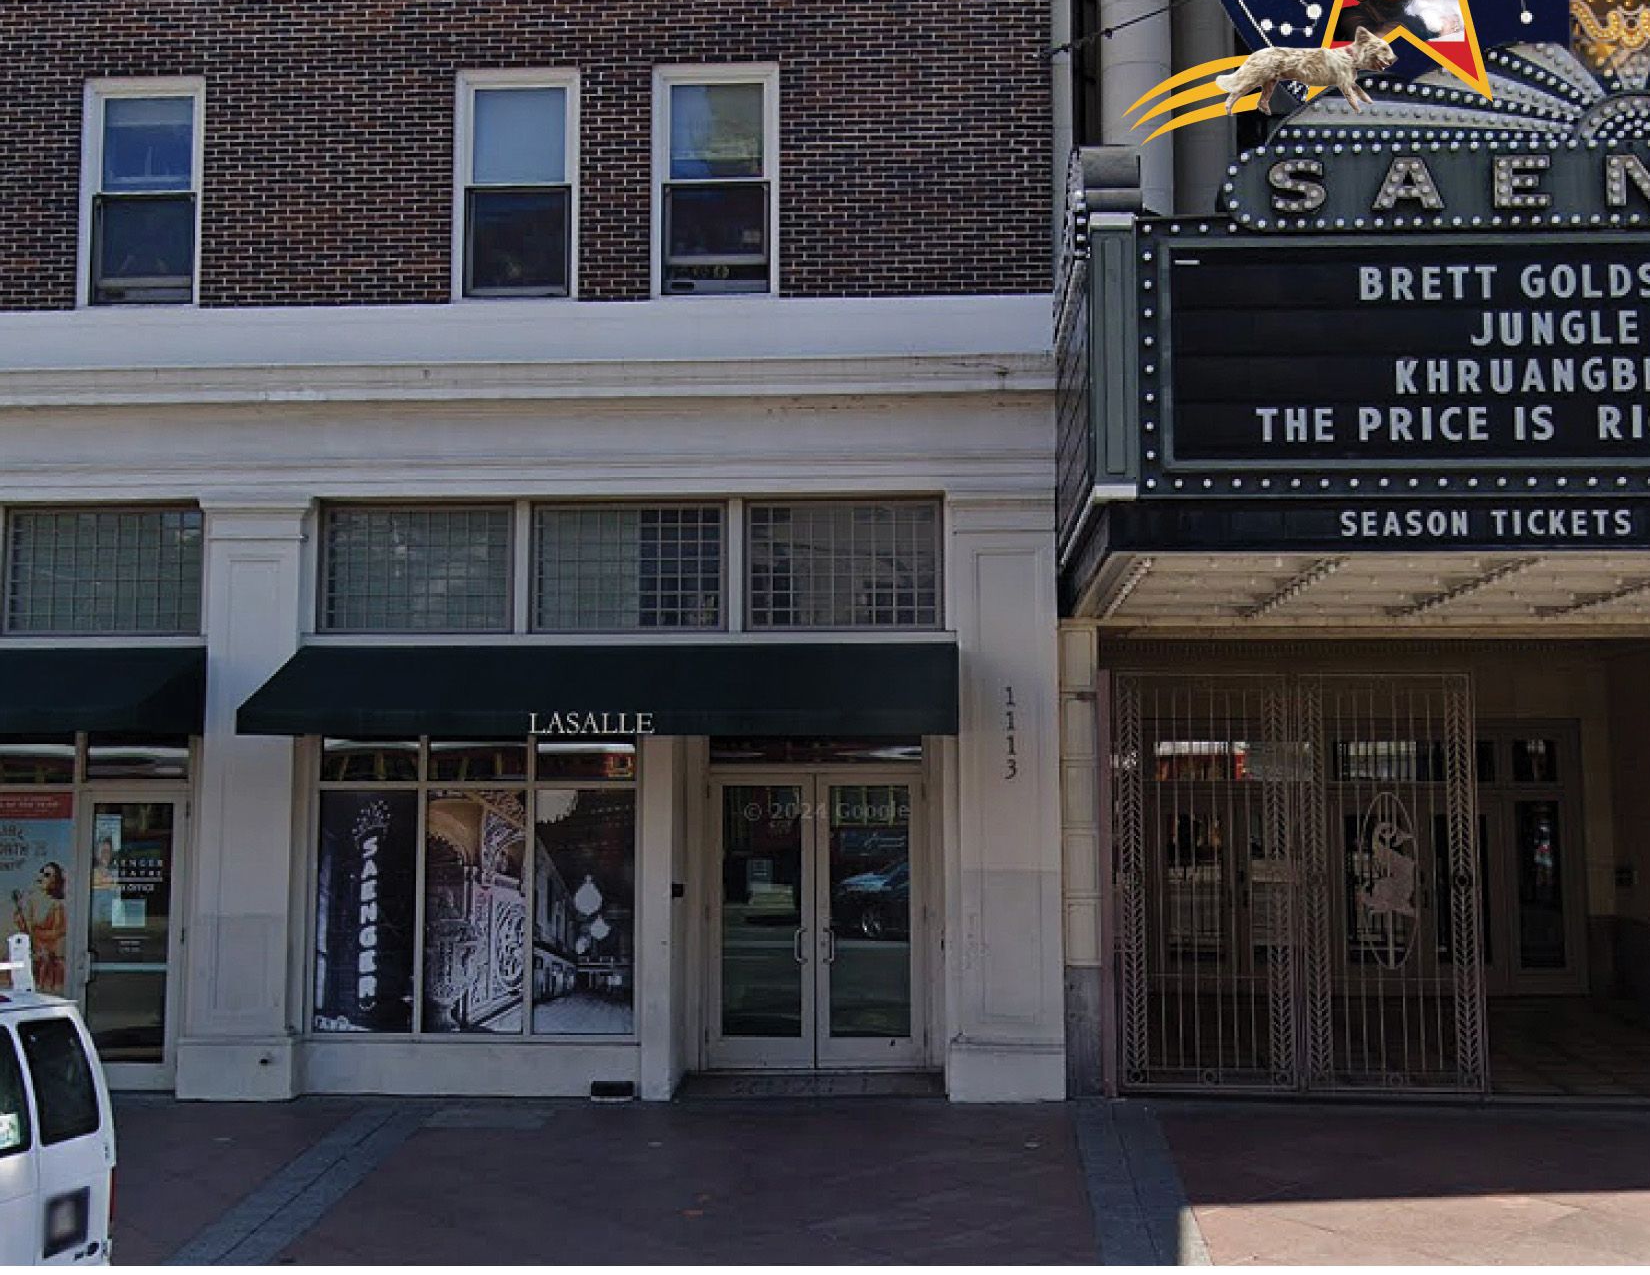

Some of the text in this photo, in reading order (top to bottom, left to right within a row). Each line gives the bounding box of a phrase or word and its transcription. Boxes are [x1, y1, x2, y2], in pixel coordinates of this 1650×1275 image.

[1361, 267, 1497, 300] BRETT
[1472, 311, 1638, 345] JUNGLE
[1256, 409, 1333, 441] THE
[1359, 407, 1488, 440] PRICE
[1515, 407, 1554, 440] IS
[1340, 510, 1468, 536] SEASON
[1491, 509, 1632, 535] TICKETS
[529, 712, 655, 734] LASALLE
[1003, 686, 1018, 780] 1113
